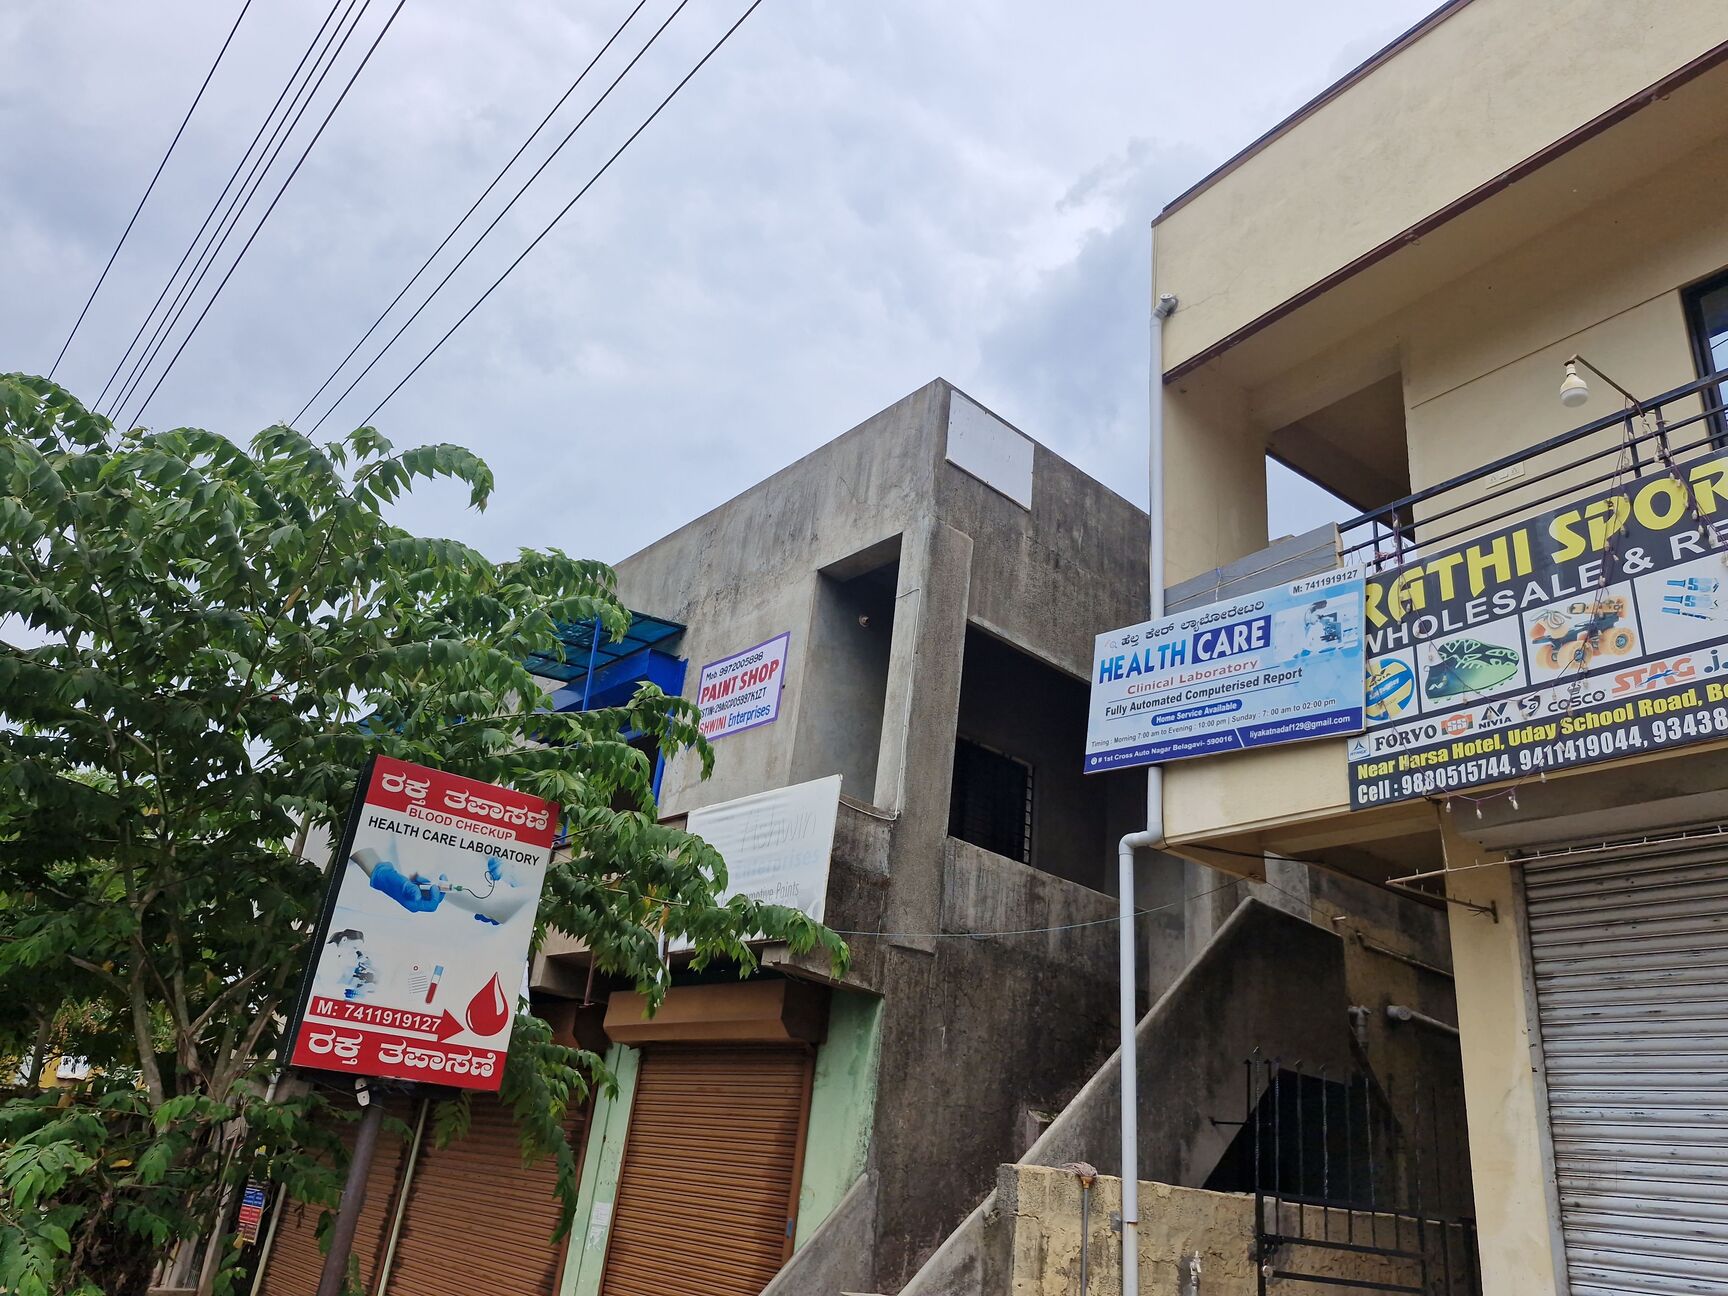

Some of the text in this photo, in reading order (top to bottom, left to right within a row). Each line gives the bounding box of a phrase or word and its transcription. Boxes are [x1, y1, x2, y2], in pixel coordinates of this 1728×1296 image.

[1622, 547, 1654, 574] &
[1293, 570, 1358, 595] M: 7411919127
[1099, 618, 1265, 684] HEALTH CARE
[700, 659, 780, 705] PAINT SHOP
[1127, 659, 1259, 696] Clinical Laboratory
[1611, 656, 1696, 694] STAG
[1105, 667, 1303, 717] Fully Automated Computerised Report
[1547, 690, 1605, 713] COSCO
[728, 704, 772, 728] Enterprises
[1091, 740, 1110, 748] Timing
[1114, 734, 1136, 744] Morning
[1168, 725, 1193, 735] Evening
[1198, 720, 1215, 729] 10:00
[1216, 718, 1227, 727] pm
[1231, 712, 1256, 724] Sunday
[1302, 700, 1322, 710] 02:00
[1324, 698, 1336, 707] pm
[1156, 700, 1238, 724] Home Service Available
[1478, 717, 1512, 730] NIVIA
[1103, 755, 1114, 763] 1st
[1114, 752, 1133, 760] Cross
[1133, 749, 1149, 758] Auto
[1151, 746, 1171, 755] Nagar
[1206, 735, 1233, 746] 590016
[1357, 760, 1396, 780] Near
[1398, 748, 1449, 772] Harsa
[1452, 734, 1505, 759] Hotel,
[1508, 722, 1557, 747] Uday
[1560, 702, 1634, 735] School
[1638, 688, 1703, 722] Road,
[1375, 725, 1437, 751] FORVO
[382, 772, 549, 831] ರಕ್ತ ತಪಾಸಣೆ
[1357, 780, 1390, 804] Cell
[368, 815, 540, 866] HEALTH CARE LABORATORY
[409, 808, 513, 841] BLOOD CHECKUP
[316, 999, 442, 1032] M: 7411919127
[308, 1029, 496, 1078] ರಕ್ತ ತಪಾಸಣೆ
